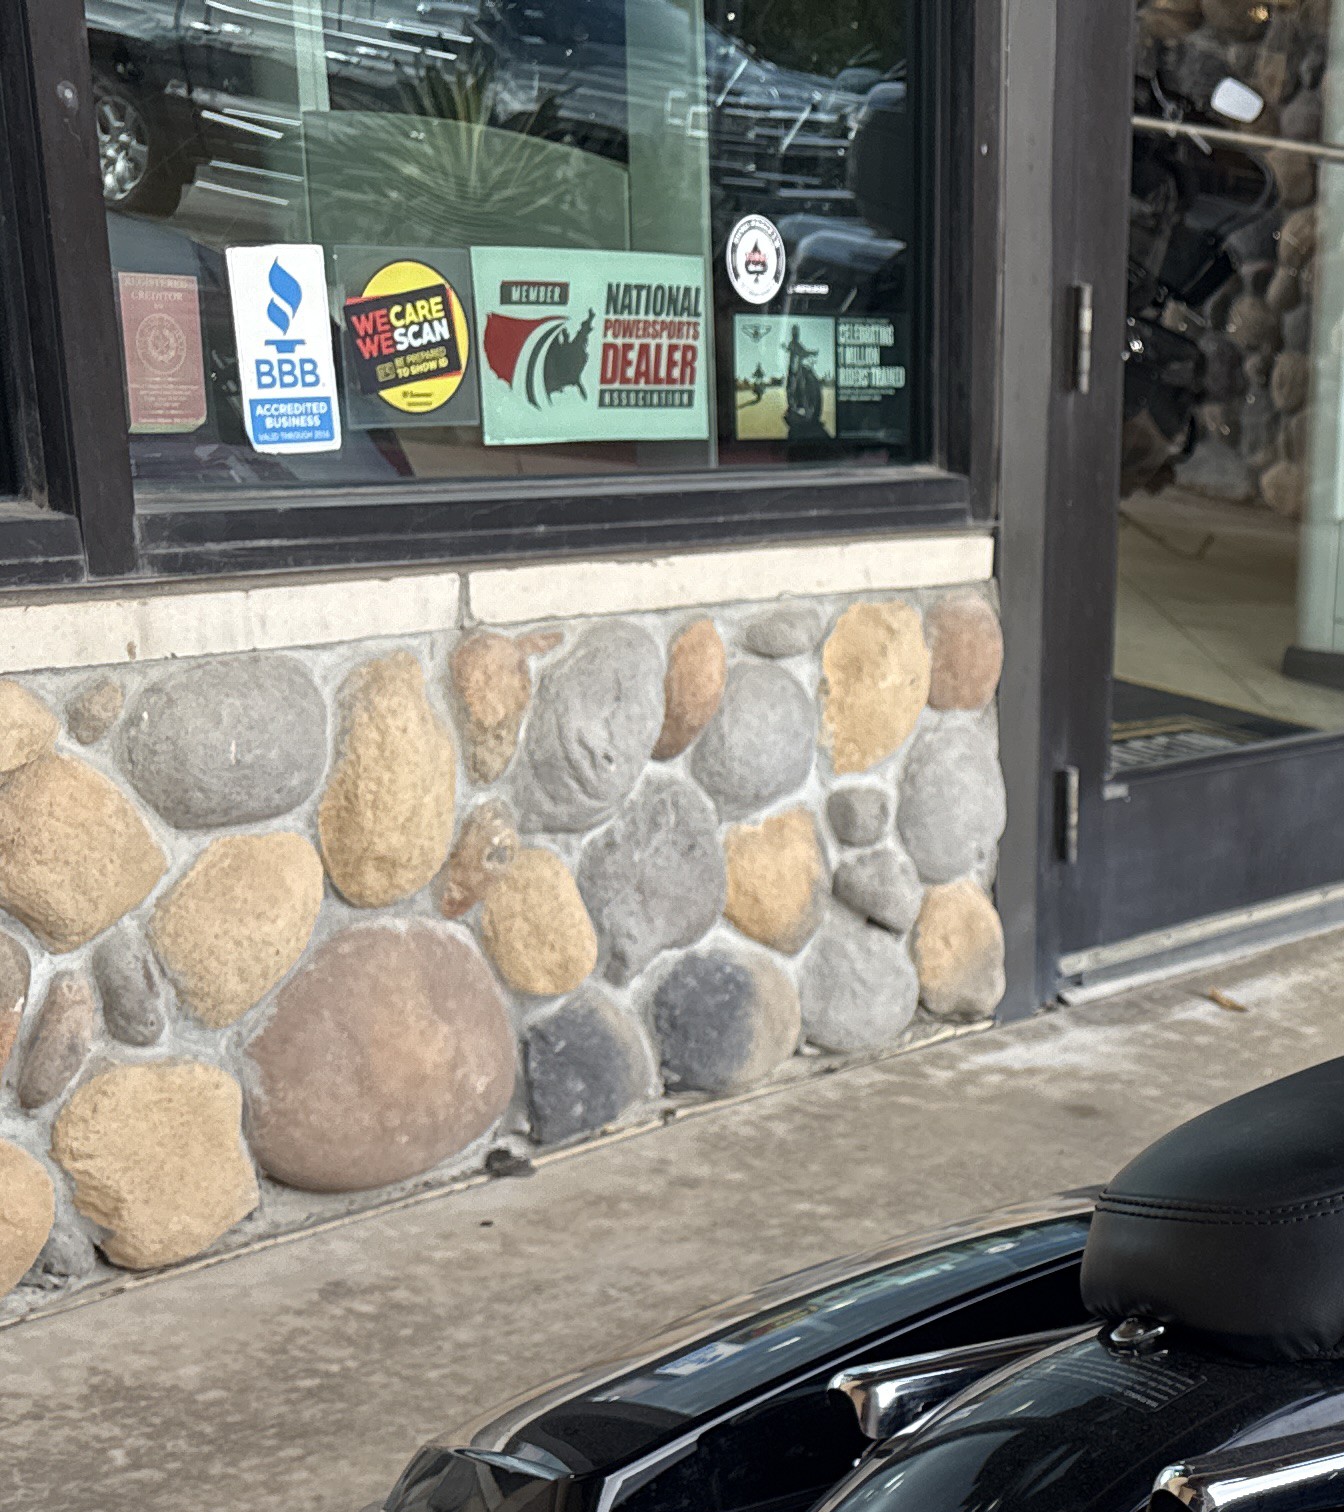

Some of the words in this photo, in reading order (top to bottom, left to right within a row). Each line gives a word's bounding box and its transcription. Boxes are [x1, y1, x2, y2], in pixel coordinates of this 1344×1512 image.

[511, 286, 561, 302] MEMBER
[605, 281, 702, 317] NATIONAL
[603, 318, 700, 340] POWERSPORTS
[255, 358, 320, 389] BBB
[600, 342, 698, 386] DEALER
[604, 390, 689, 406] ASSOCIATION
[255, 402, 328, 416] ACCREDITED
[265, 415, 321, 429] BUSINESS
